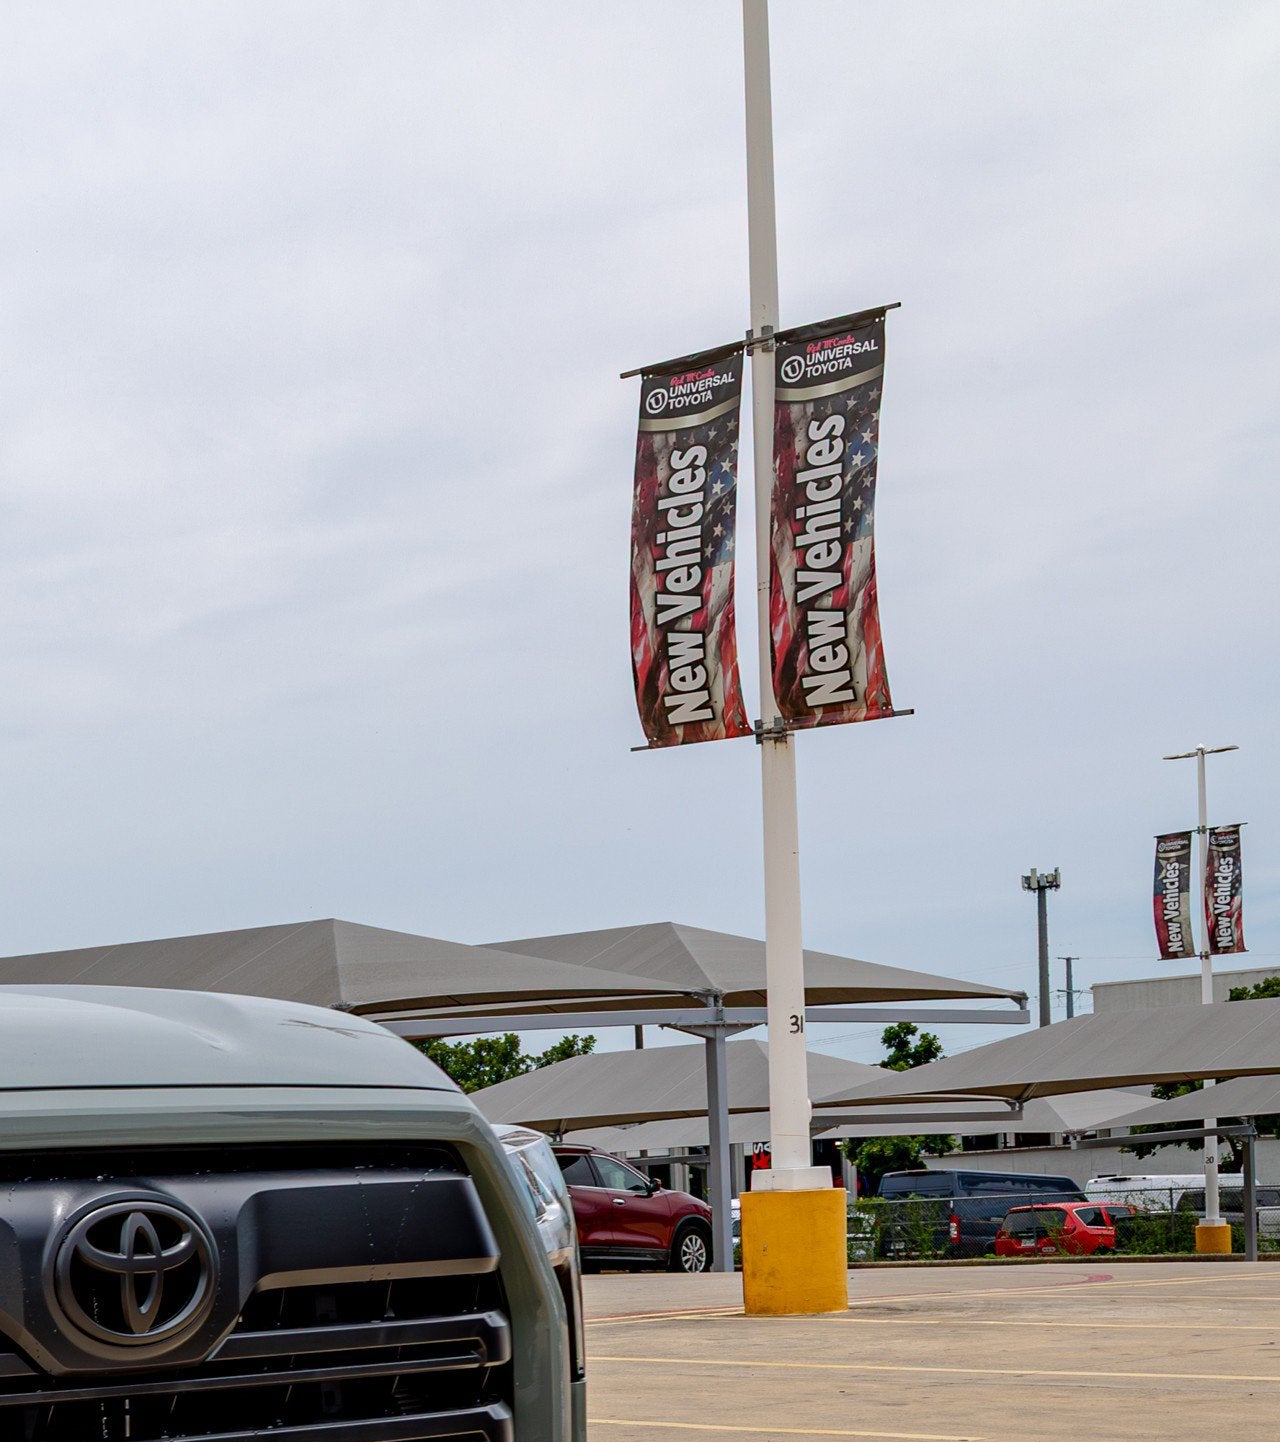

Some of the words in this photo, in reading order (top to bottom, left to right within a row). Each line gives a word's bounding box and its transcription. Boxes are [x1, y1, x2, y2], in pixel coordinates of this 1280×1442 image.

[805, 357, 853, 378] TOYOTA
[806, 339, 878, 365] UNIVERSAL
[668, 390, 713, 410] TOYOTA
[669, 372, 735, 397] UNIVERSAL
[795, 414, 846, 604] Vehicles
[655, 444, 707, 625] Vehicles
[802, 610, 855, 707] New
[664, 632, 714, 725] New
[1163, 861, 1180, 920] Vehicles
[1213, 856, 1234, 916] Vehicles
[1167, 922, 1184, 952] New
[1216, 916, 1234, 947] New
[789, 1014, 804, 1034] 31
